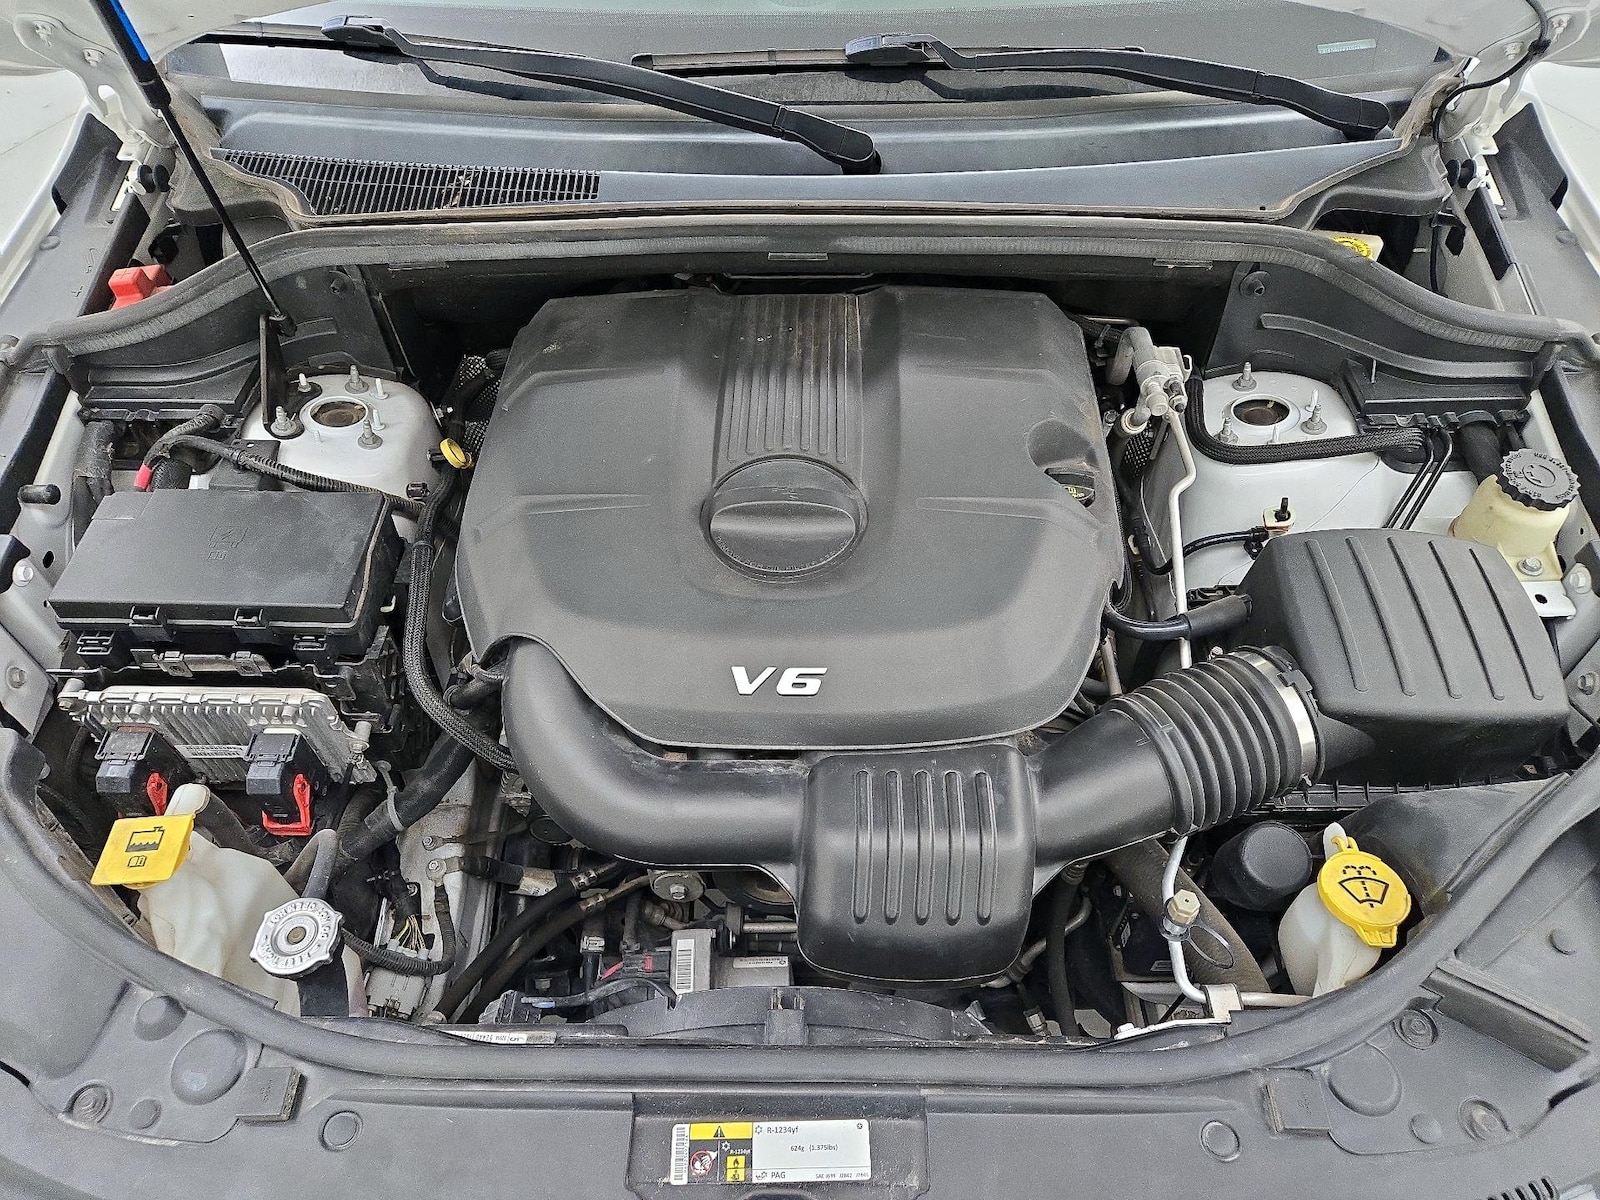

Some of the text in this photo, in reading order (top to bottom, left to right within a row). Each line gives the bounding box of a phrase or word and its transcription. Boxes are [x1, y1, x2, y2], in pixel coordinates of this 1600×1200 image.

[731, 666, 828, 696] V6
[767, 1126, 798, 1135] R-1234yf
[808, 1144, 839, 1152] (1.375lbs)
[771, 1171, 786, 1180] PAG
